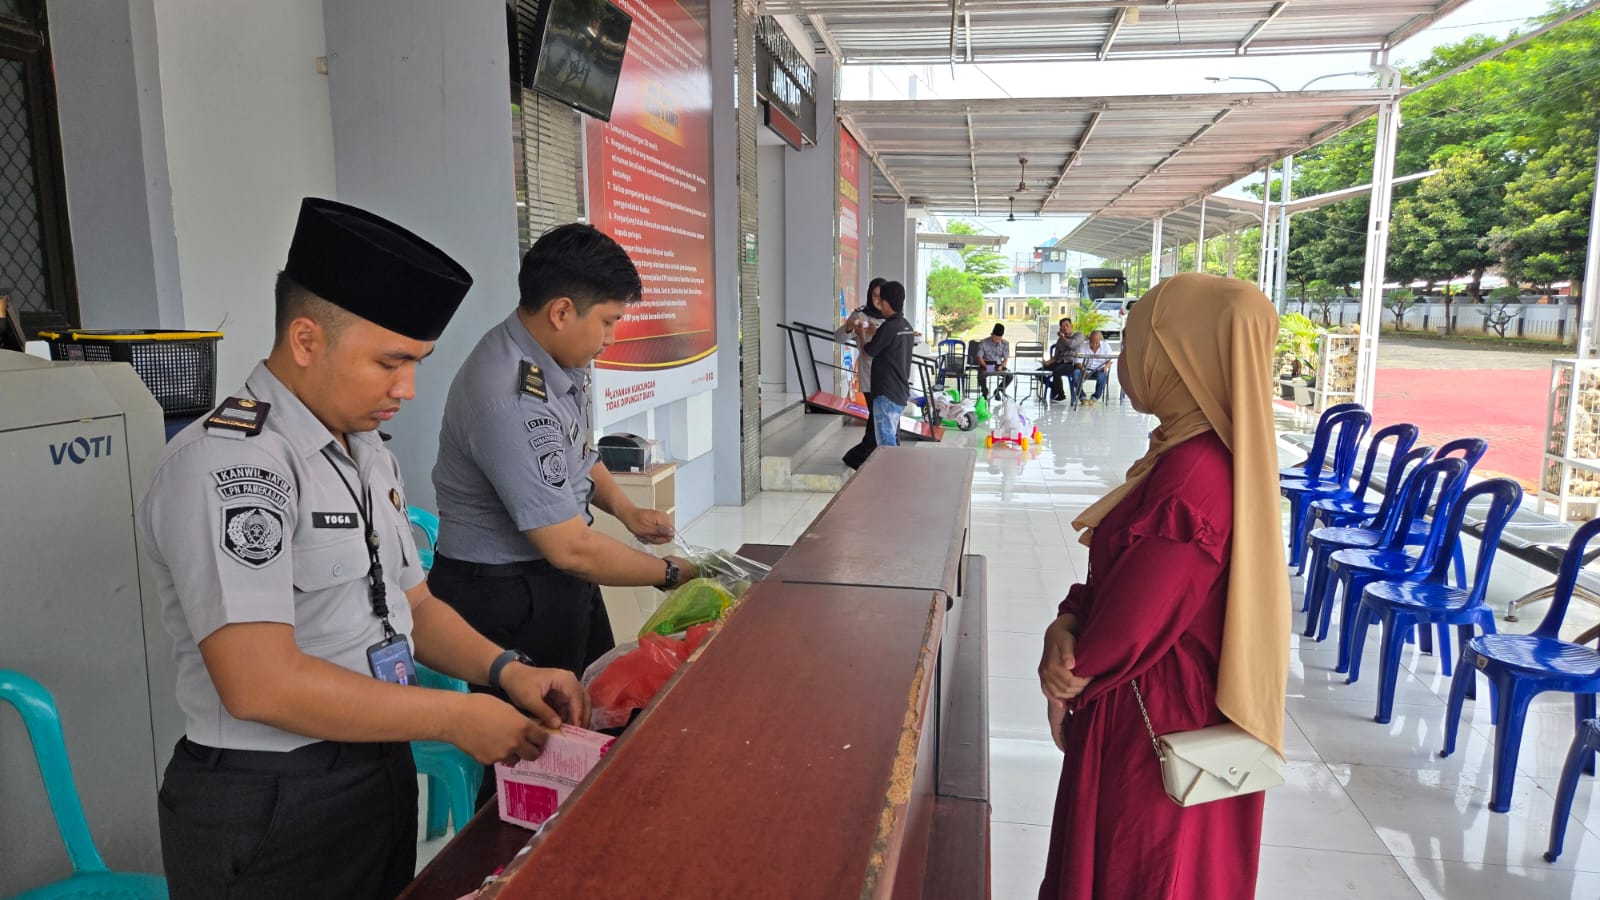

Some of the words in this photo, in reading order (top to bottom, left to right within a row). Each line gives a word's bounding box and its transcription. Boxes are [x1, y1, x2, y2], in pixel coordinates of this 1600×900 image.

[605, 399, 620, 412] TIDAK
[48, 434, 112, 466] VOTI
[220, 468, 264, 481] KANWIL
[265, 472, 291, 494] JATIM
[223, 484, 241, 497] LPN
[242, 484, 288, 506] PAMEKASAN
[324, 515, 351, 525] YOGA
